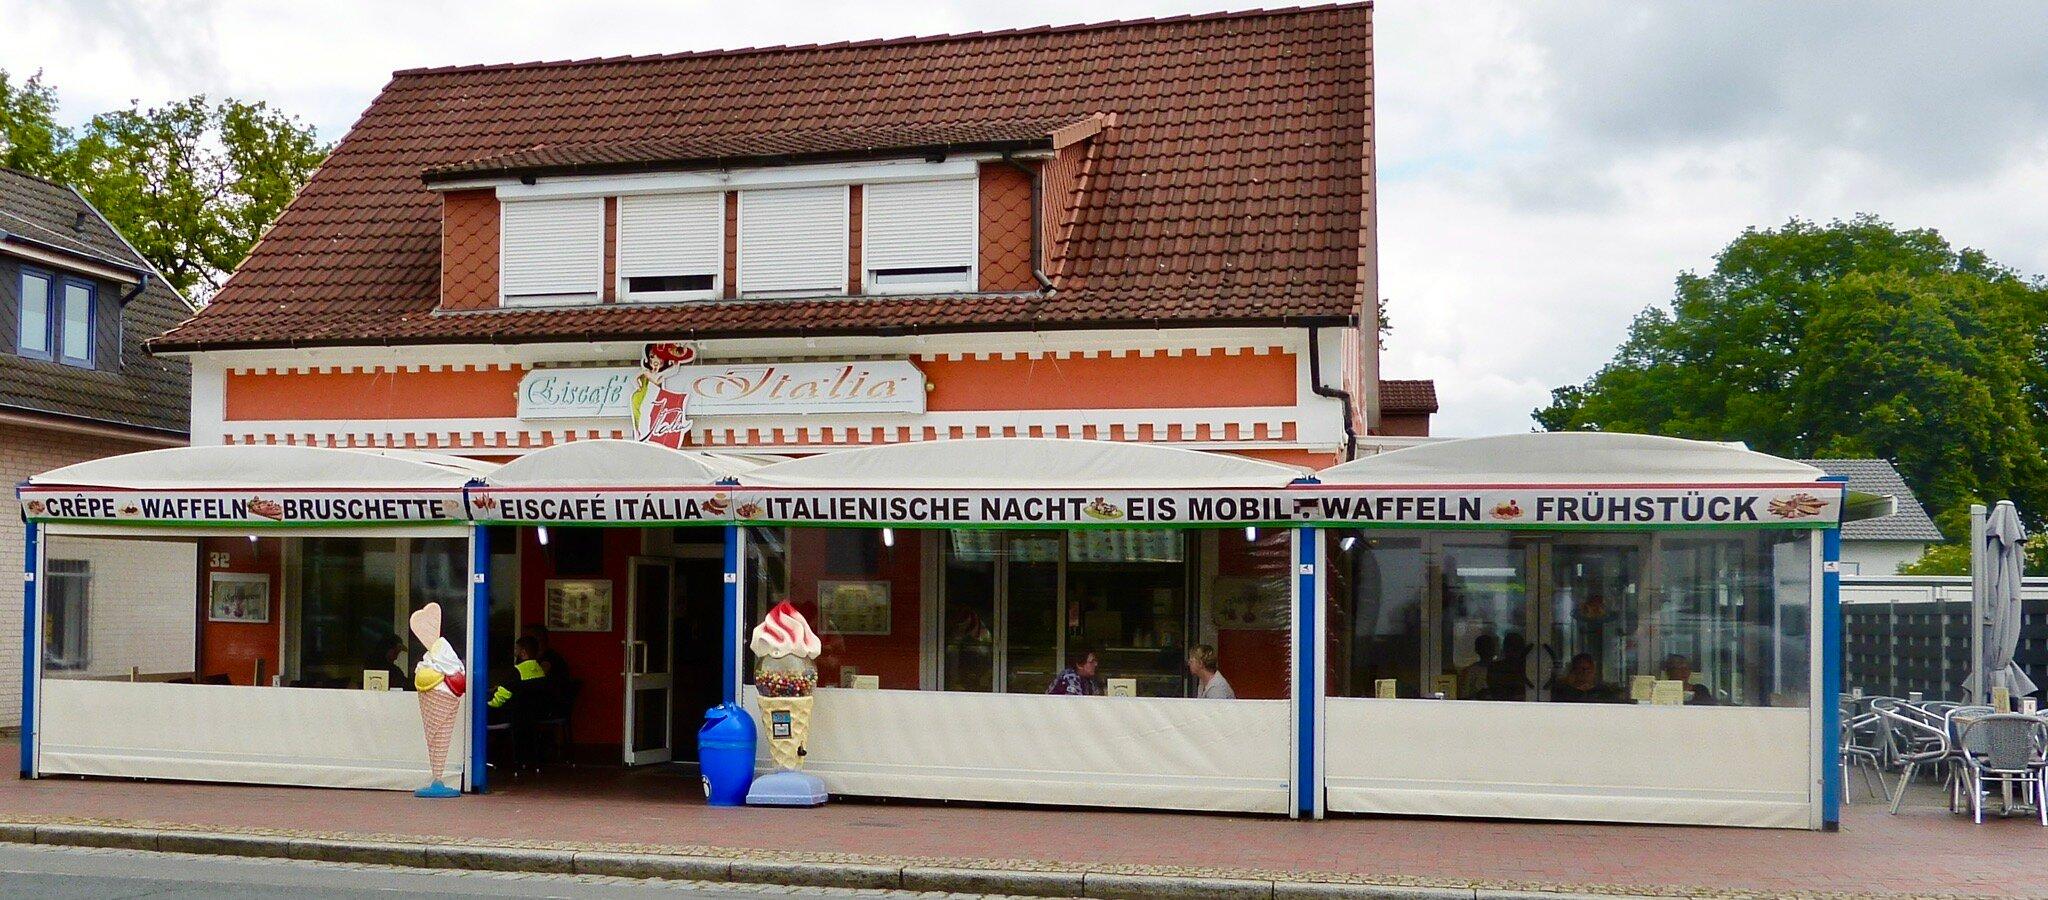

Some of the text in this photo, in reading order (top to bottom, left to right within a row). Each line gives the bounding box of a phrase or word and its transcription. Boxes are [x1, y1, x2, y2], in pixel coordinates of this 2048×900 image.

[527, 374, 629, 416] Eiscafé
[45, 493, 446, 520] CRÊPE WAFFELN BRUSCHETTE
[500, 494, 703, 520] EISCAFÉ ITÁLIA
[765, 497, 1292, 521] ITALIENISCHE NACHT EIS MOBIL
[1320, 491, 1759, 522] WAFFELN FRÜHSTÜCK
[209, 552, 231, 568] 32
